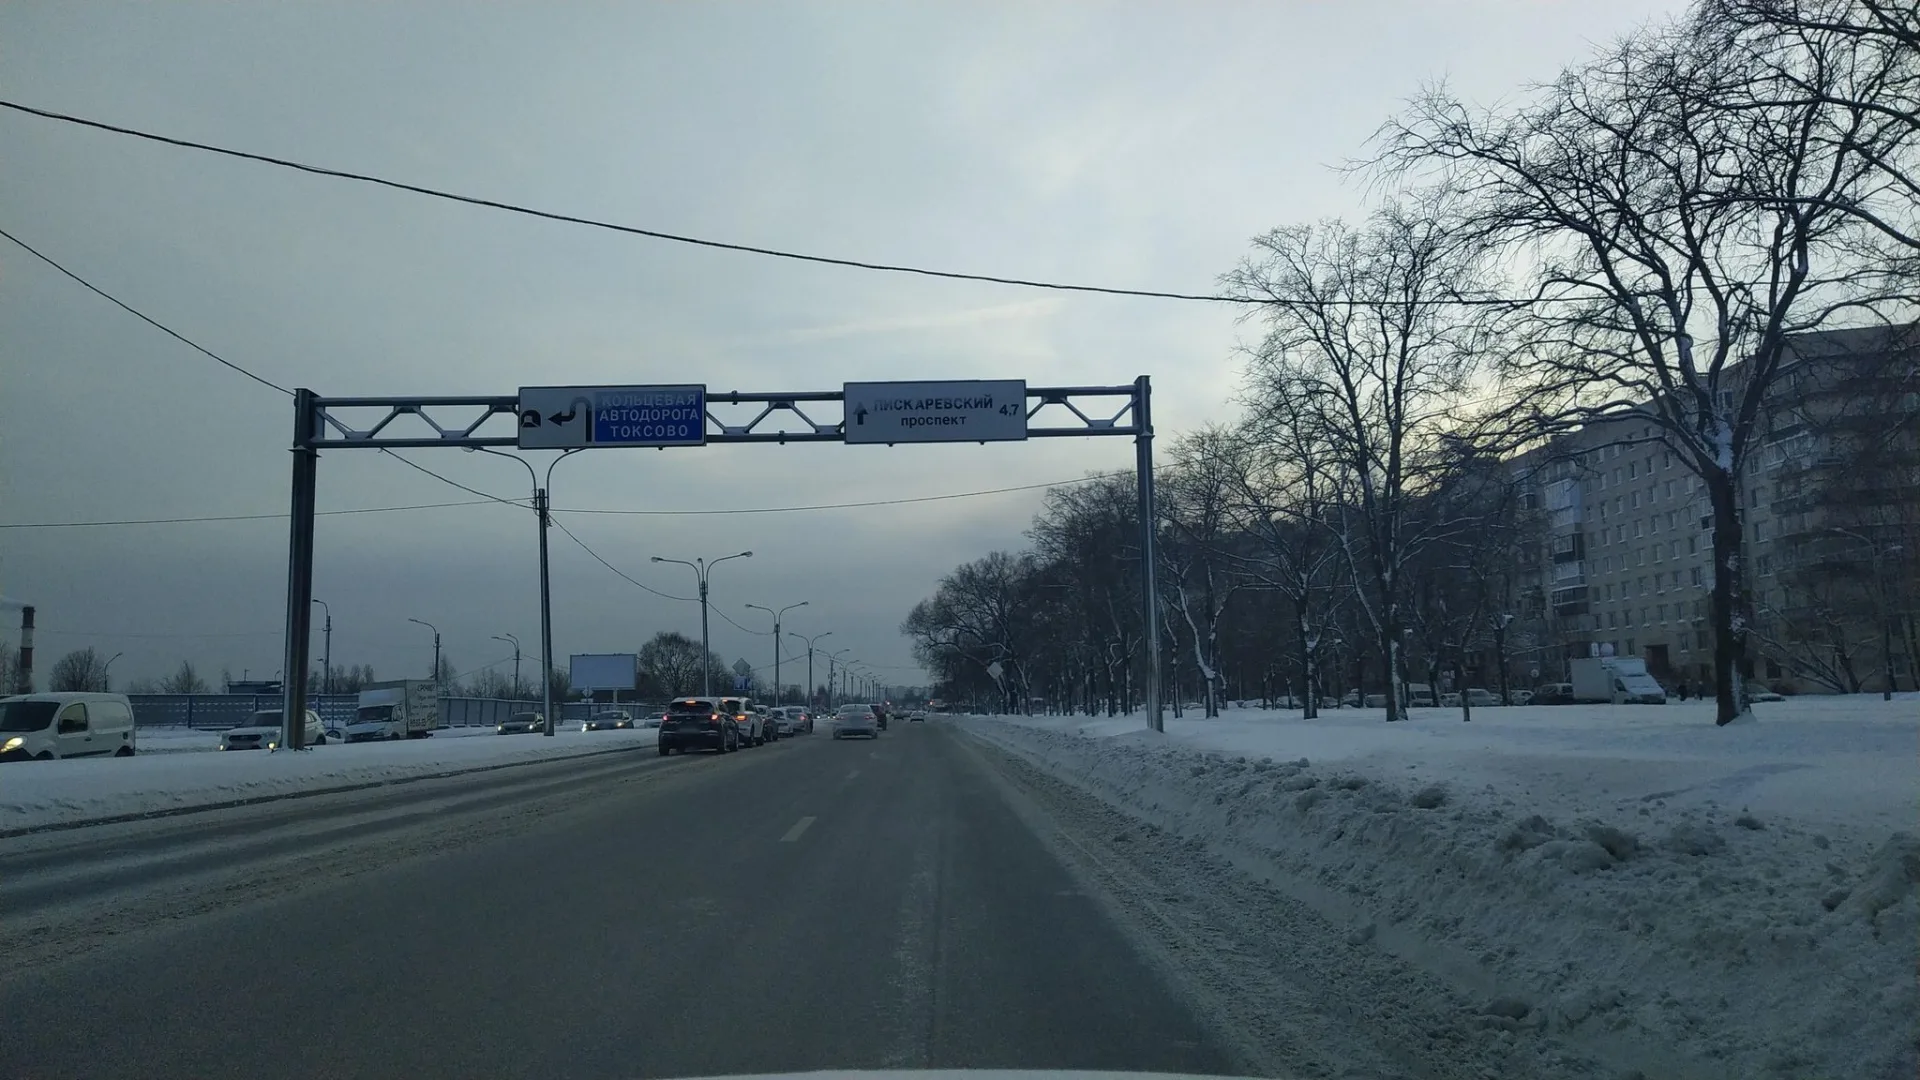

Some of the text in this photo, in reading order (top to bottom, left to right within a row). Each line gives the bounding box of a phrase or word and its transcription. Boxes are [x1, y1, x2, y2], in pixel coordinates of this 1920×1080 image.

[602, 393, 697, 407] КОЛЬЦЕВАЯ
[873, 394, 993, 412] ПИСКАРЕВСКИЙ
[600, 408, 699, 422] АВТОДОРОГА
[999, 403, 1020, 416] 4,7
[901, 415, 967, 428] проспект
[610, 425, 688, 438] ТОКСОВО
